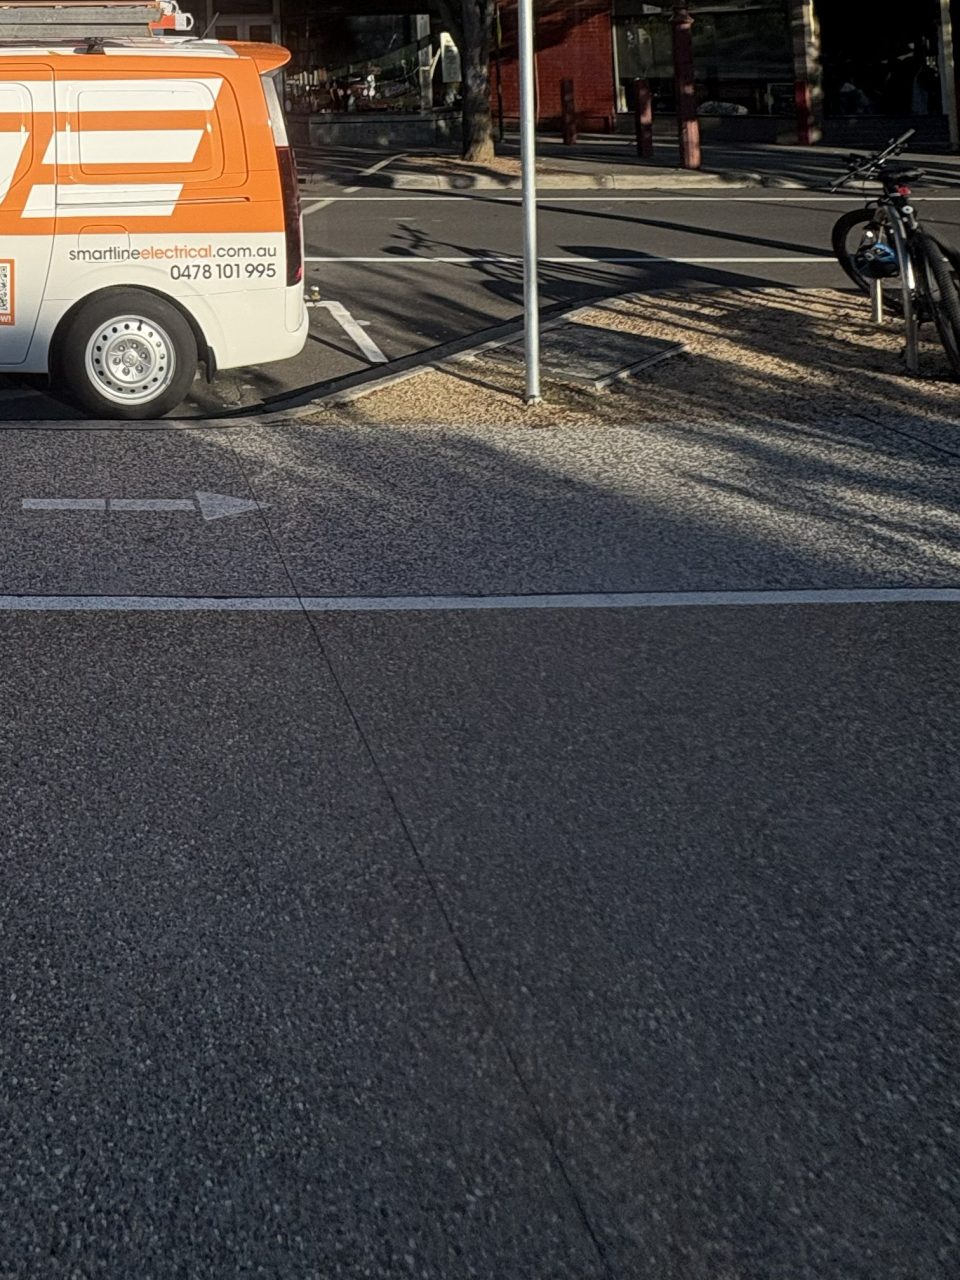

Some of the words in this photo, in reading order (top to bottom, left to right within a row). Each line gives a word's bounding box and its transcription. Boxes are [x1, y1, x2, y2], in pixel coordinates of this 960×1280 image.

[69, 244, 276, 261] smartlineelectrical.com.au
[170, 264, 212, 280] 0478
[216, 264, 241, 279] 101
[244, 263, 276, 278] 995
